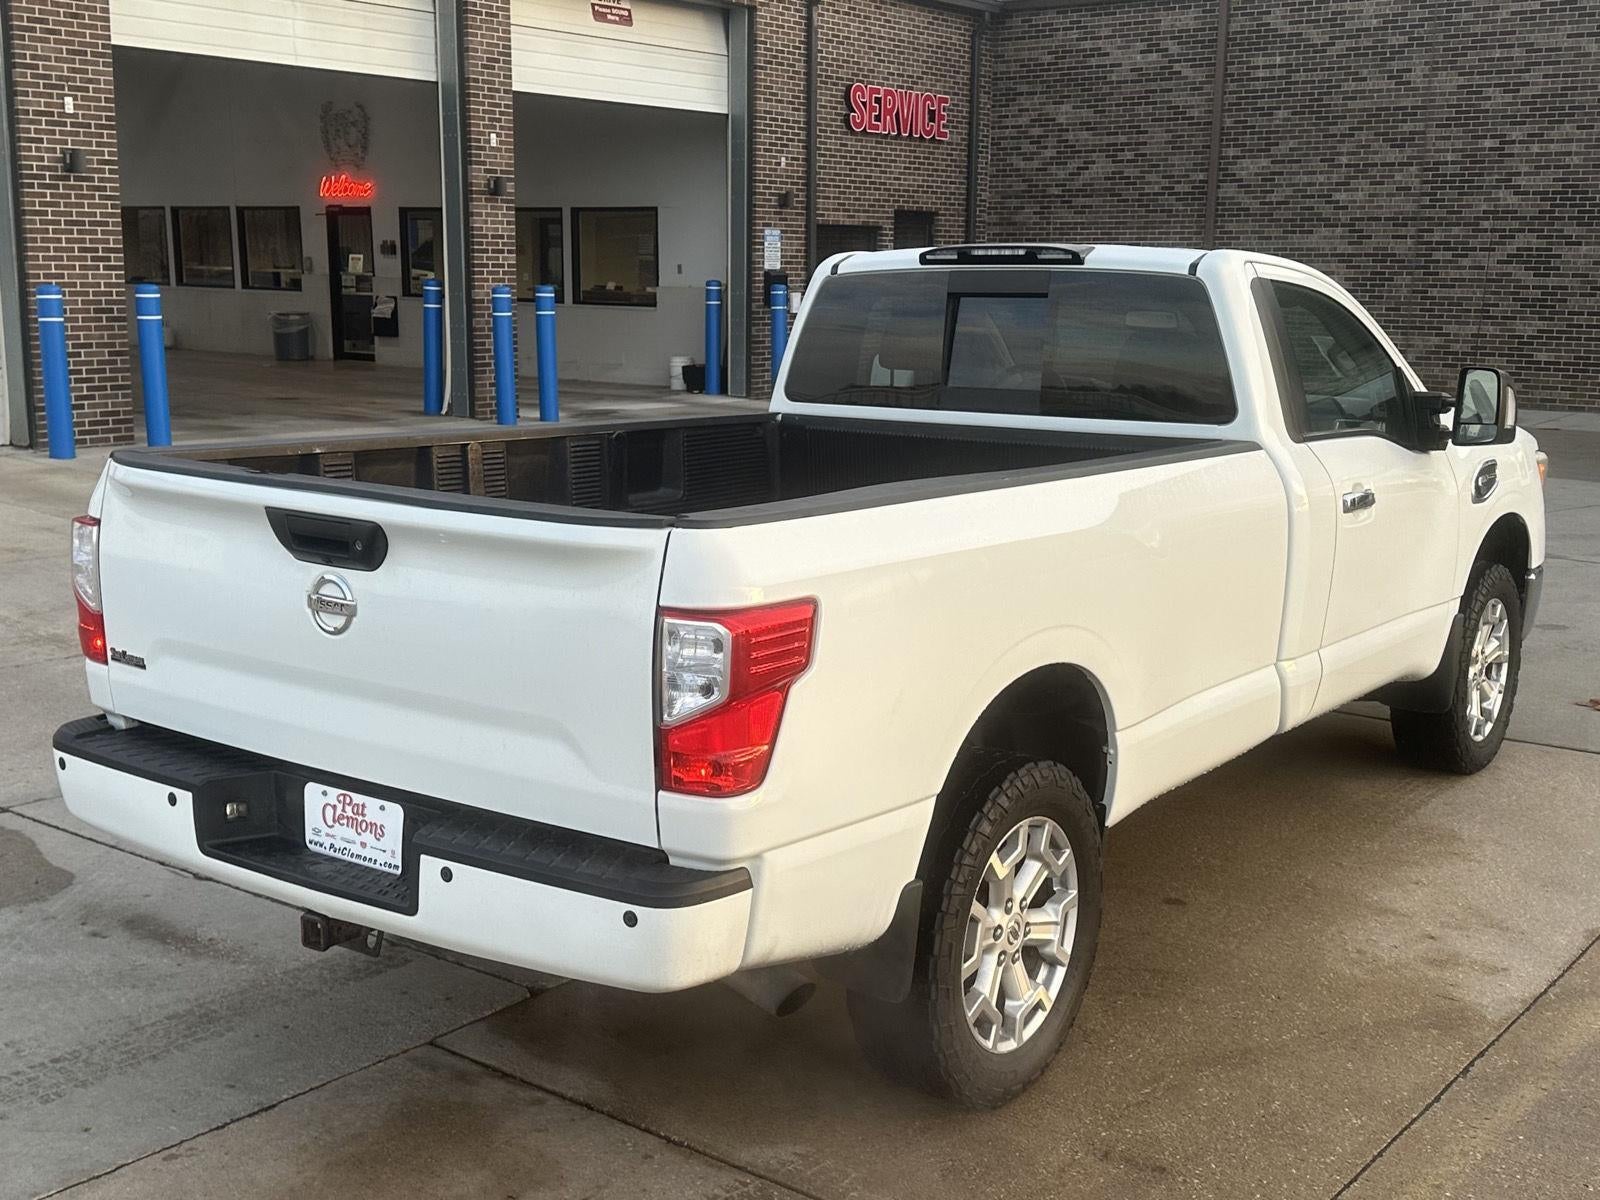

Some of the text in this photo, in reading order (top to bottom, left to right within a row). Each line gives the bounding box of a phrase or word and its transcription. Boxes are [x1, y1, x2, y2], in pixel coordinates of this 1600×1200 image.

[850, 83, 950, 140] SERVICE
[319, 174, 374, 197] Welcome
[336, 792, 367, 818] Pat
[322, 803, 386, 841] Clemons
[308, 838, 400, 871] www.PatClemons.com
